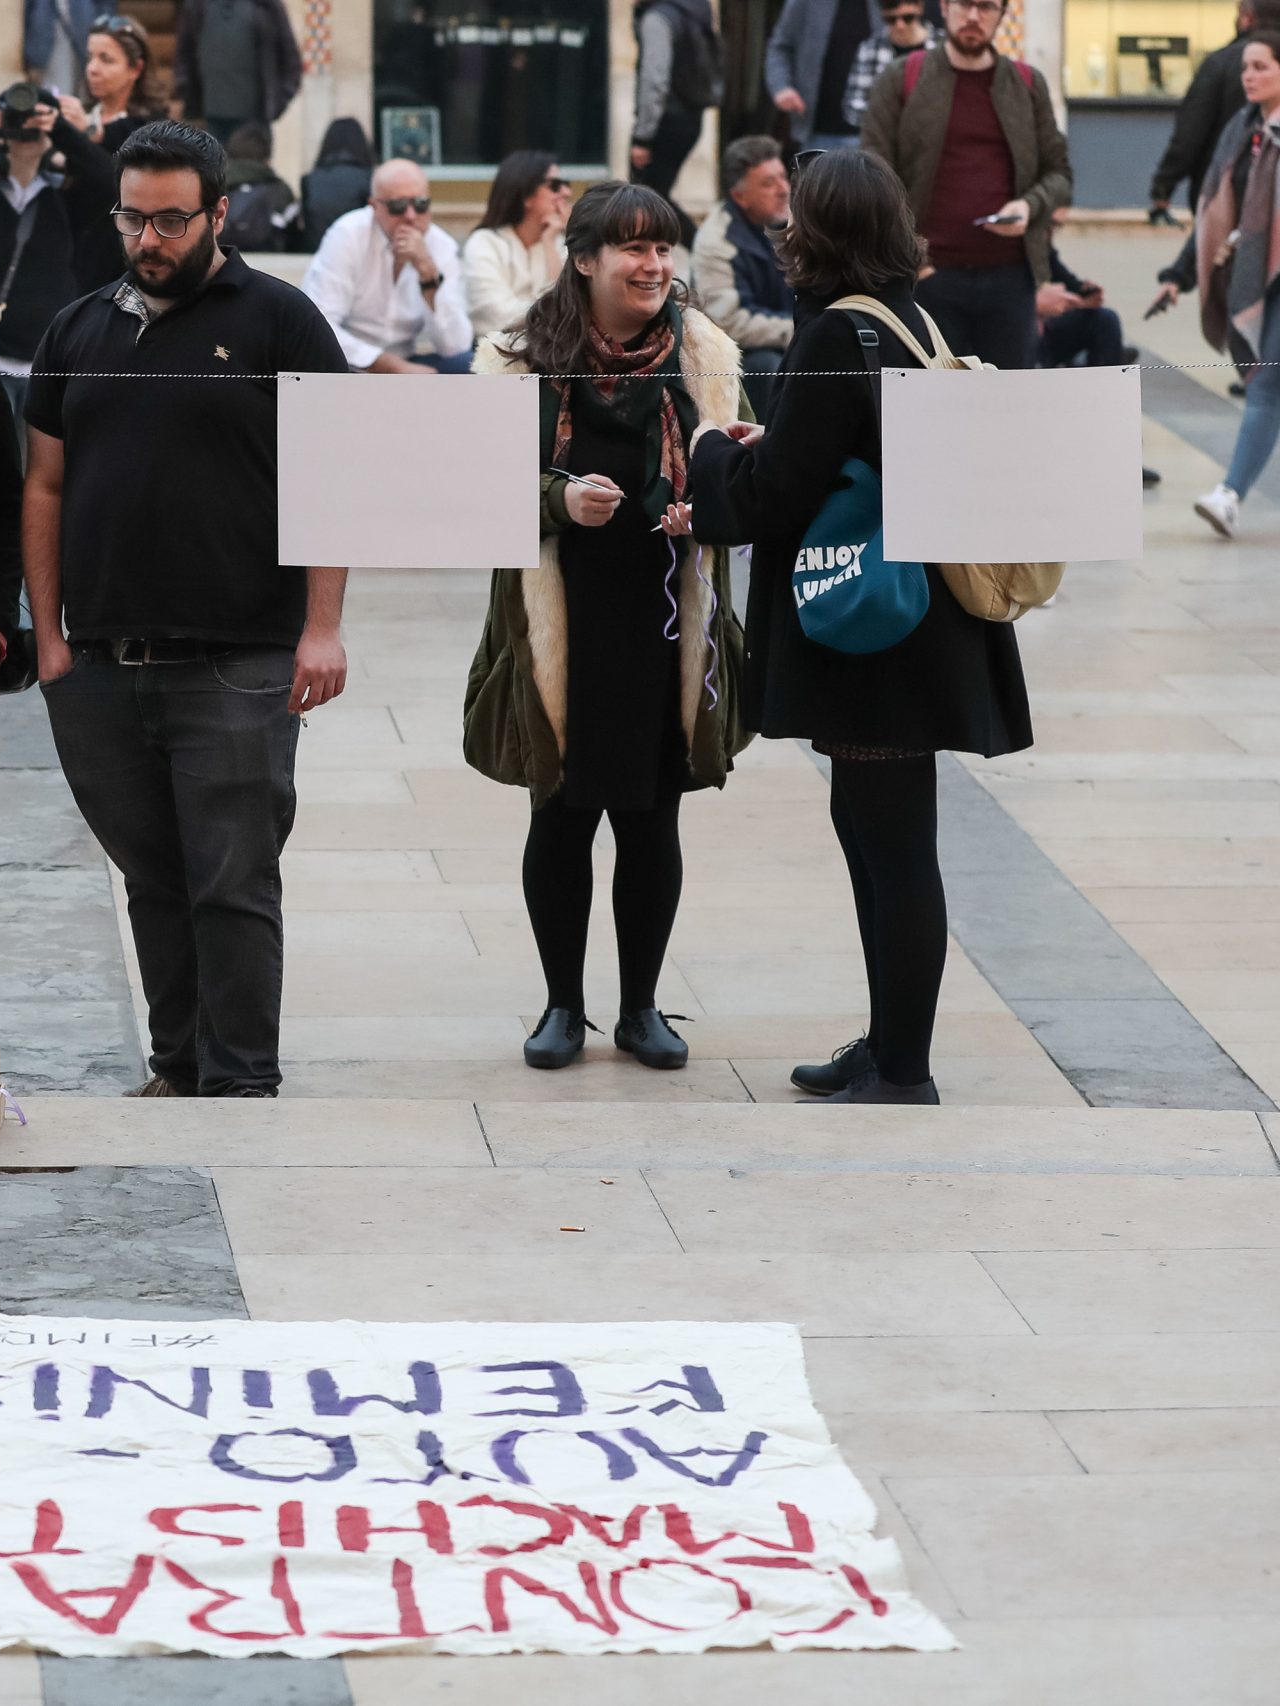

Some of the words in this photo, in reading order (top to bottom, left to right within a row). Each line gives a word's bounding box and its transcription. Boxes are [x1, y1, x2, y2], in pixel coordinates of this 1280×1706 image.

[793, 555, 862, 609] LUNCH
[794, 542, 868, 572] ENJOY
[10, 1553, 888, 1641] CONTRA
